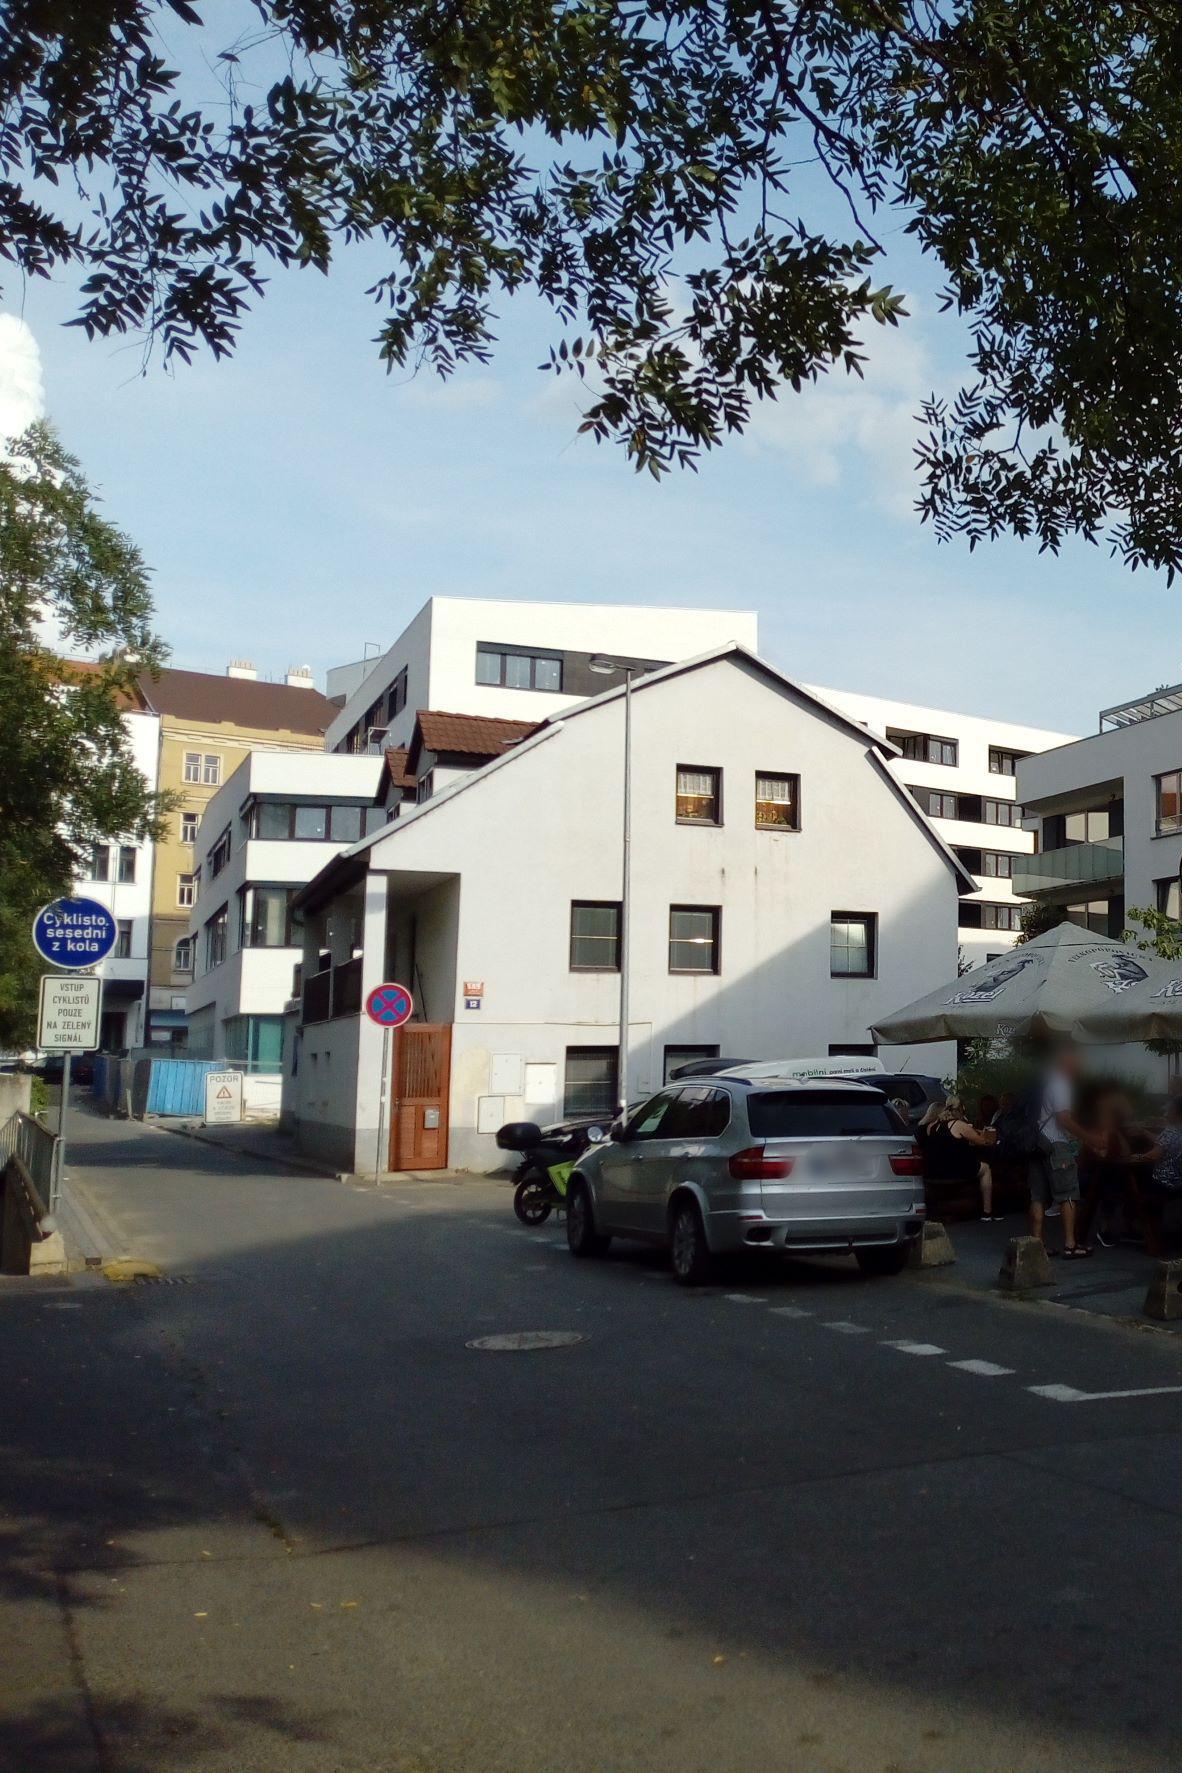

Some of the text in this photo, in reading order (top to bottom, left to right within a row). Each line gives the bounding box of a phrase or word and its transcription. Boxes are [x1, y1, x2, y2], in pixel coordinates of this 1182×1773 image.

[43, 911, 109, 927] Cyklisto,
[52, 939, 99, 952] z kola
[60, 983, 85, 992] VSTUP
[52, 994, 90, 1005] CYKLISTŮ
[57, 1008, 83, 1017] POUZE
[46, 1021, 58, 1030] NA
[54, 1033, 83, 1043] SIGNÁL
[209, 1074, 239, 1083] POZOR
